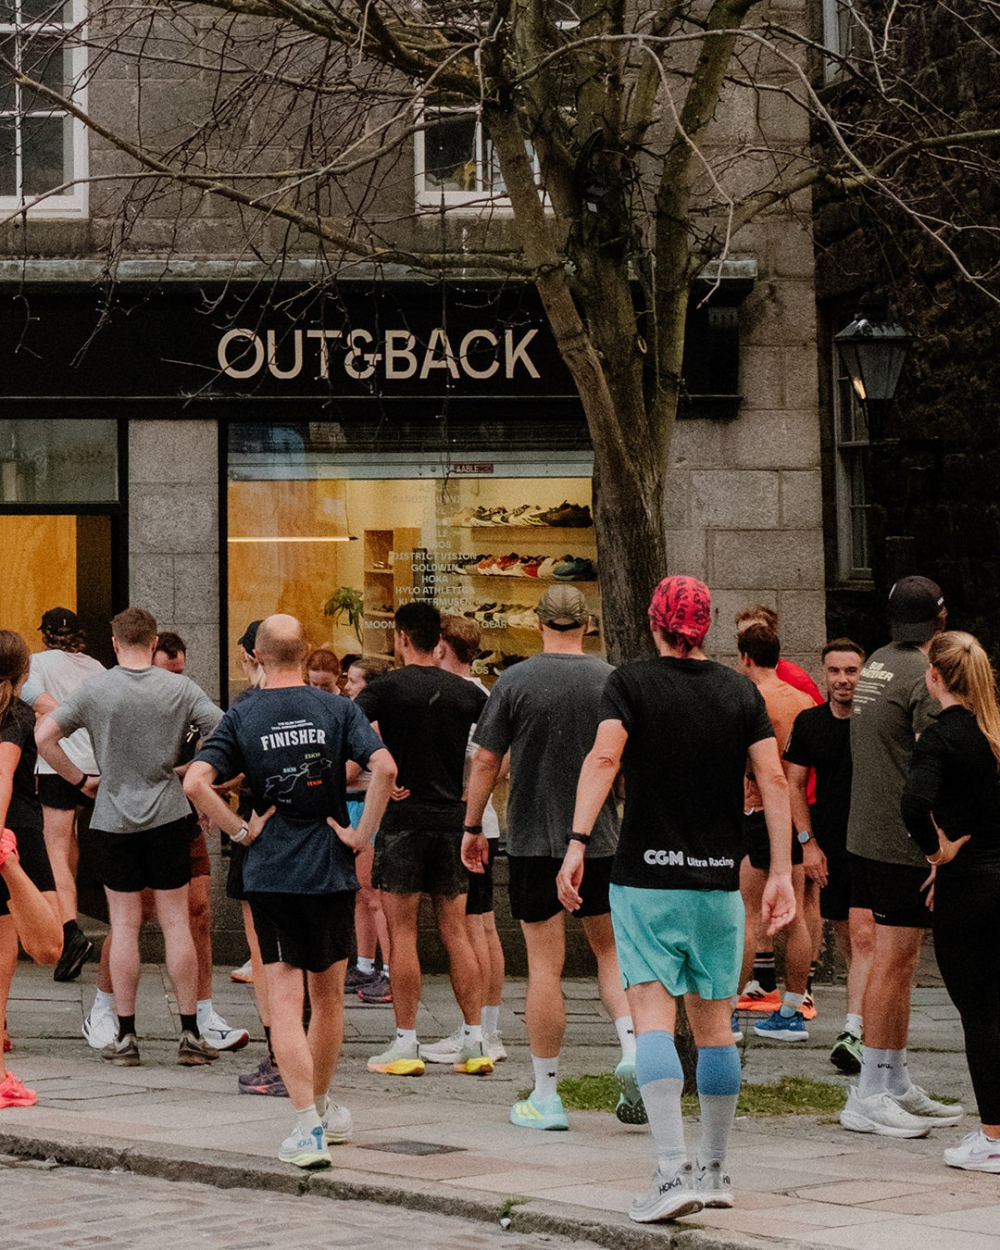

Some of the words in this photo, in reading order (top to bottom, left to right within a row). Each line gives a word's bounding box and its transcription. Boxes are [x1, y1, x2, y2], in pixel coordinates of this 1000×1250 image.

[217, 328, 541, 380] OUT&BACK
[392, 552, 438, 560] DISTRICT
[440, 552, 478, 560] VISION
[411, 564, 459, 572] GOLDWIN
[421, 575, 449, 583] HOKA
[395, 586, 421, 594] HYLO
[422, 586, 476, 594] ATHLETICS
[481, 620, 508, 629] GEAR
[260, 729, 326, 751] FINISHER
[643, 849, 684, 866] CGM
[686, 856, 708, 867] Ultra
[708, 856, 735, 869] Racing
[658, 1176, 682, 1196] HOKA
